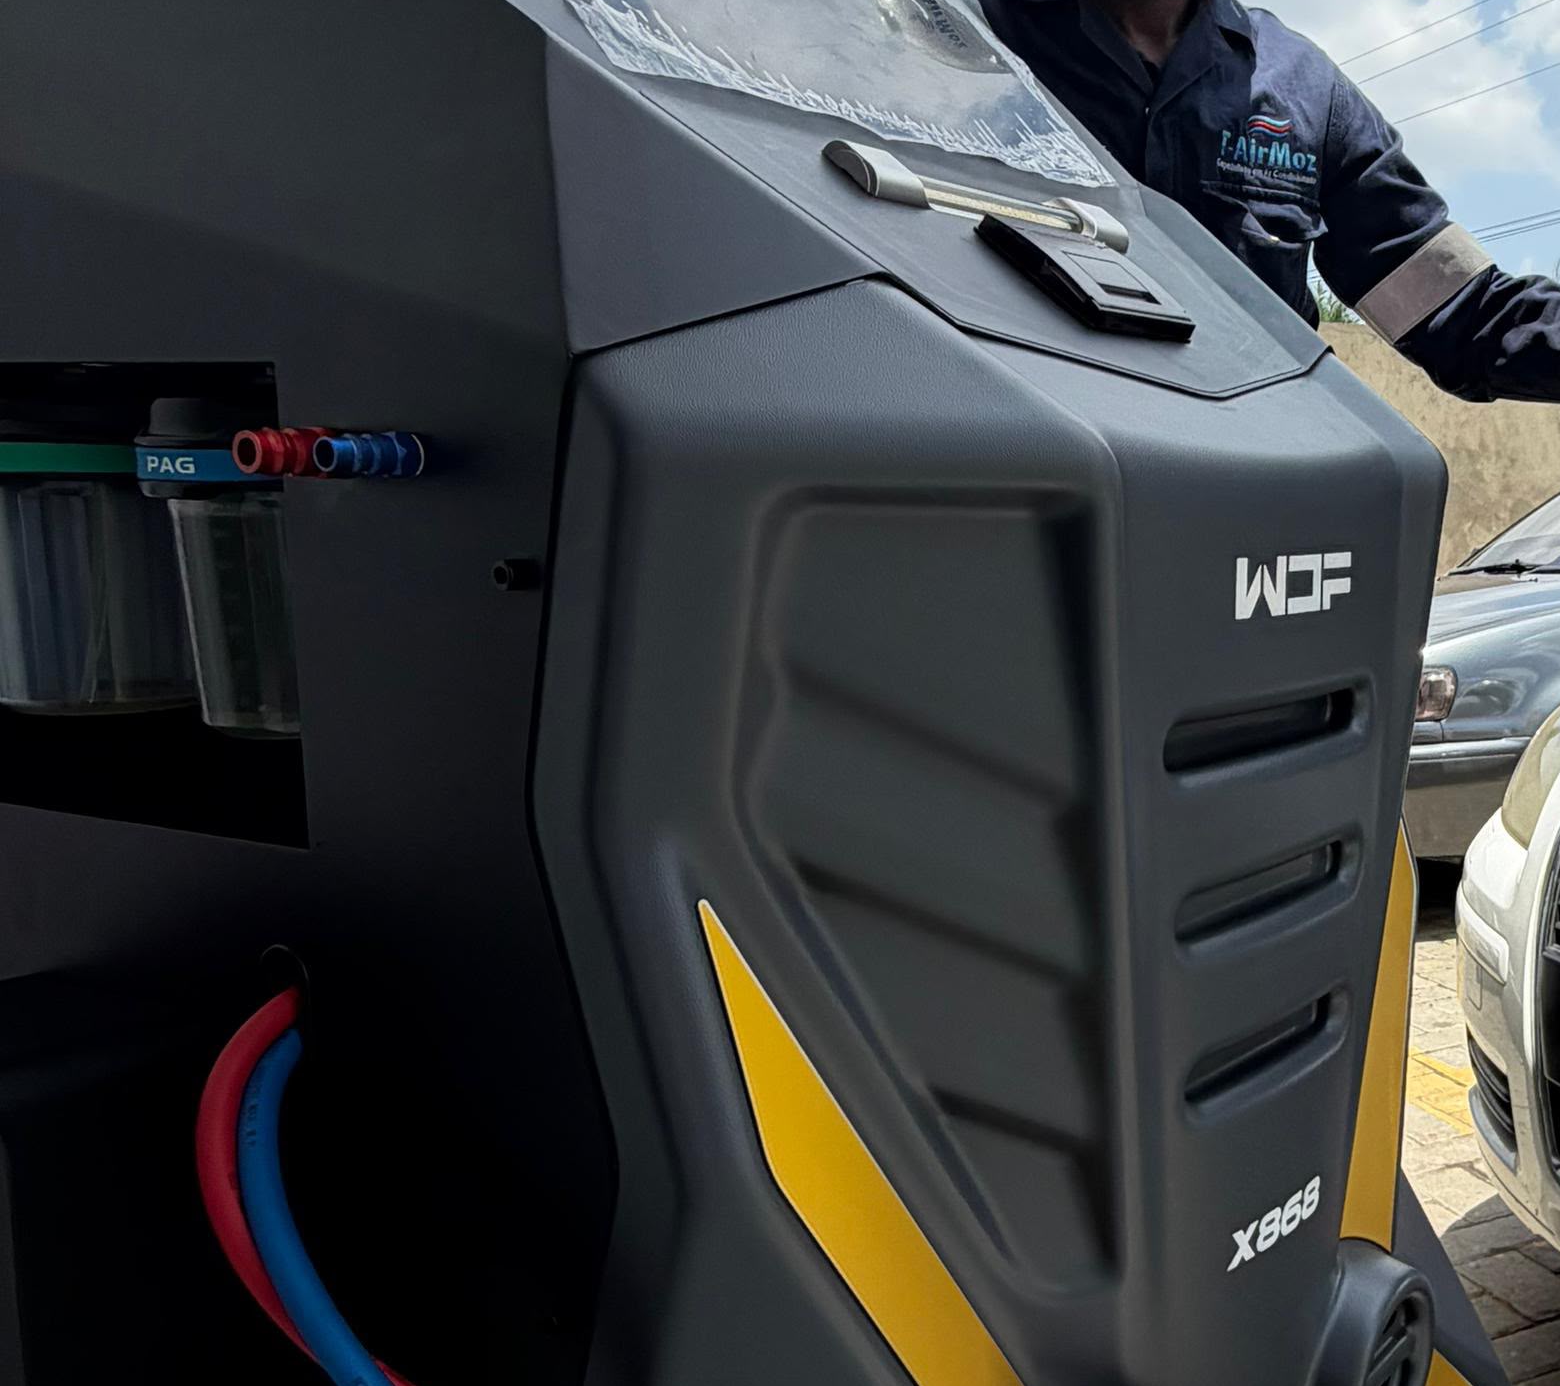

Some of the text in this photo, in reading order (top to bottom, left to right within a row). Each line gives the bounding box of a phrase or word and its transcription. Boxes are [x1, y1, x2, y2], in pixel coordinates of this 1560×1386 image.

[1220, 130, 1317, 172] T-AirMoz
[146, 455, 196, 474] PAG
[1226, 1175, 1321, 1272] X868
